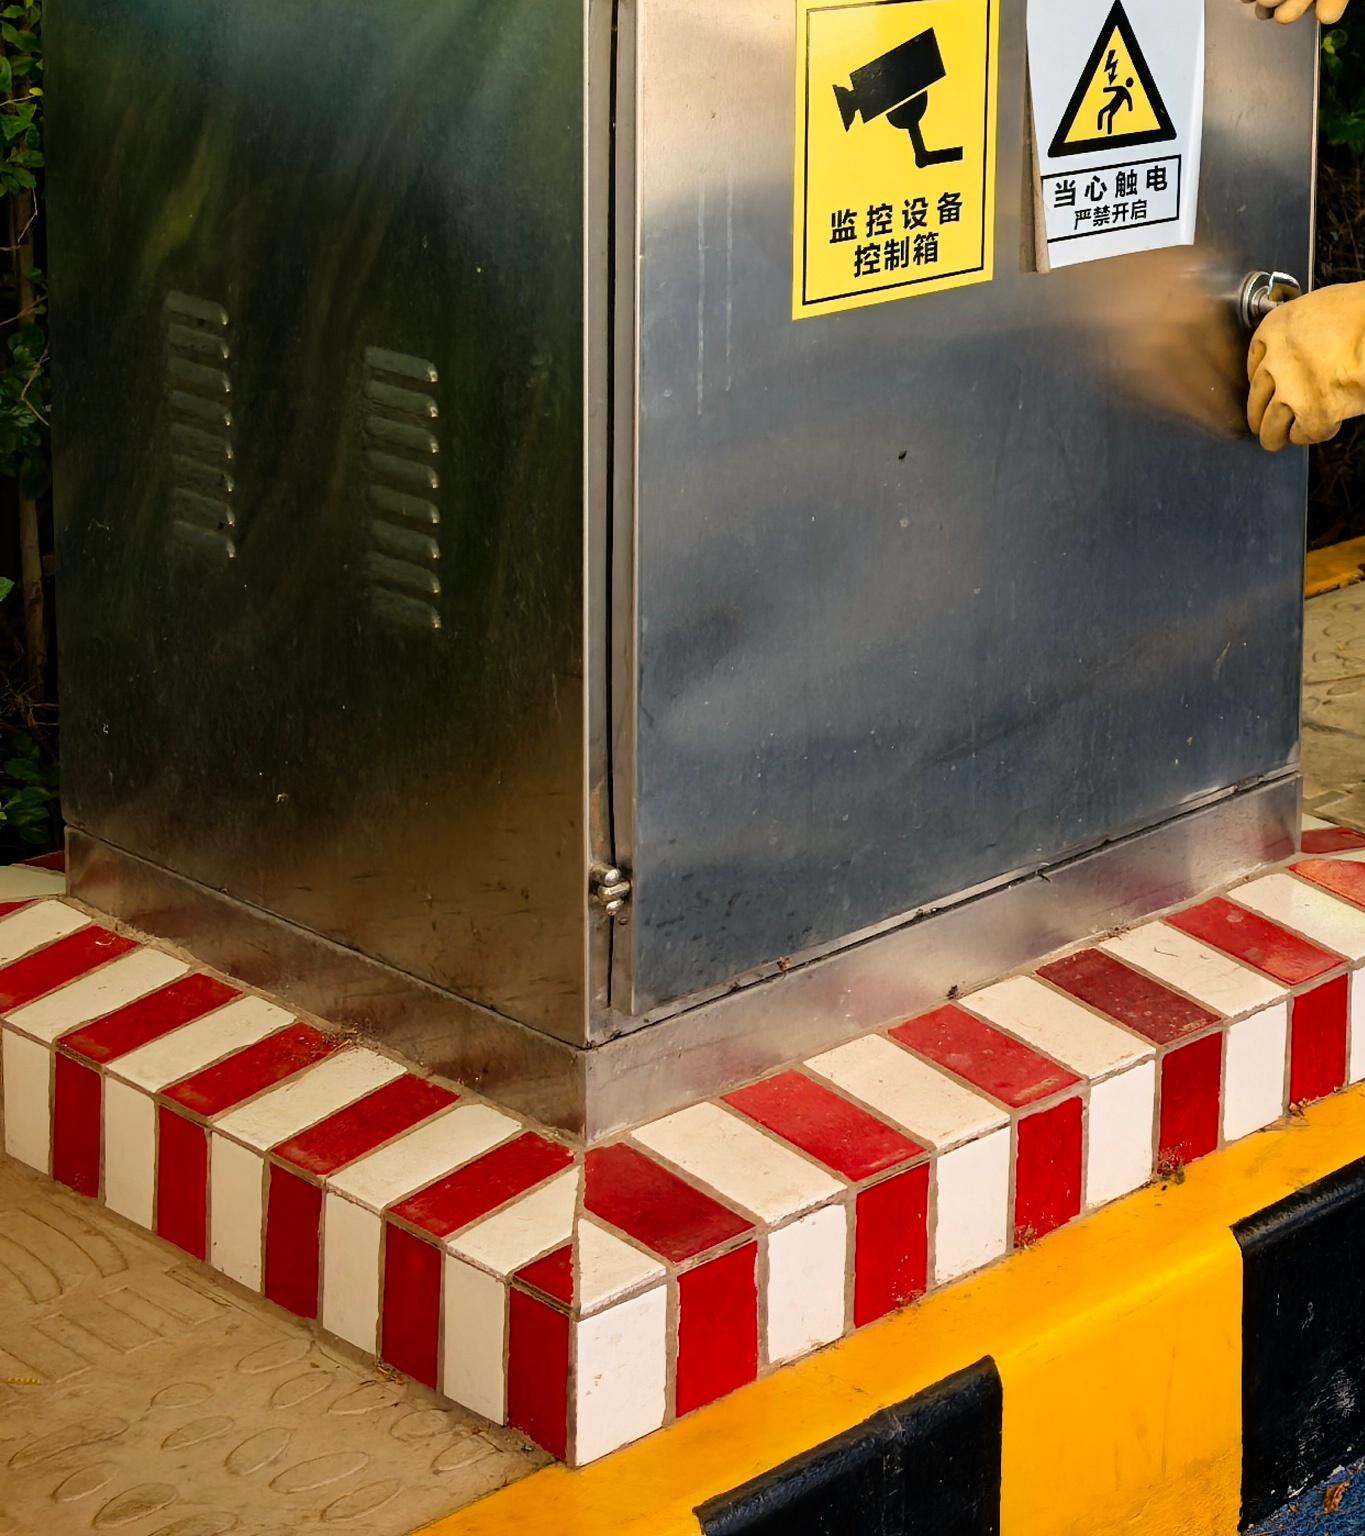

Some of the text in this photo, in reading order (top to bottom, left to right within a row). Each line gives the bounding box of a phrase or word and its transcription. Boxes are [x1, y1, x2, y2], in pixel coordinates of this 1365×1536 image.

[1053, 165, 1169, 209] 当心触电
[829, 191, 964, 244] 监控设备
[1073, 199, 1148, 231] 严禁开启
[853, 231, 940, 278] 控制箱
